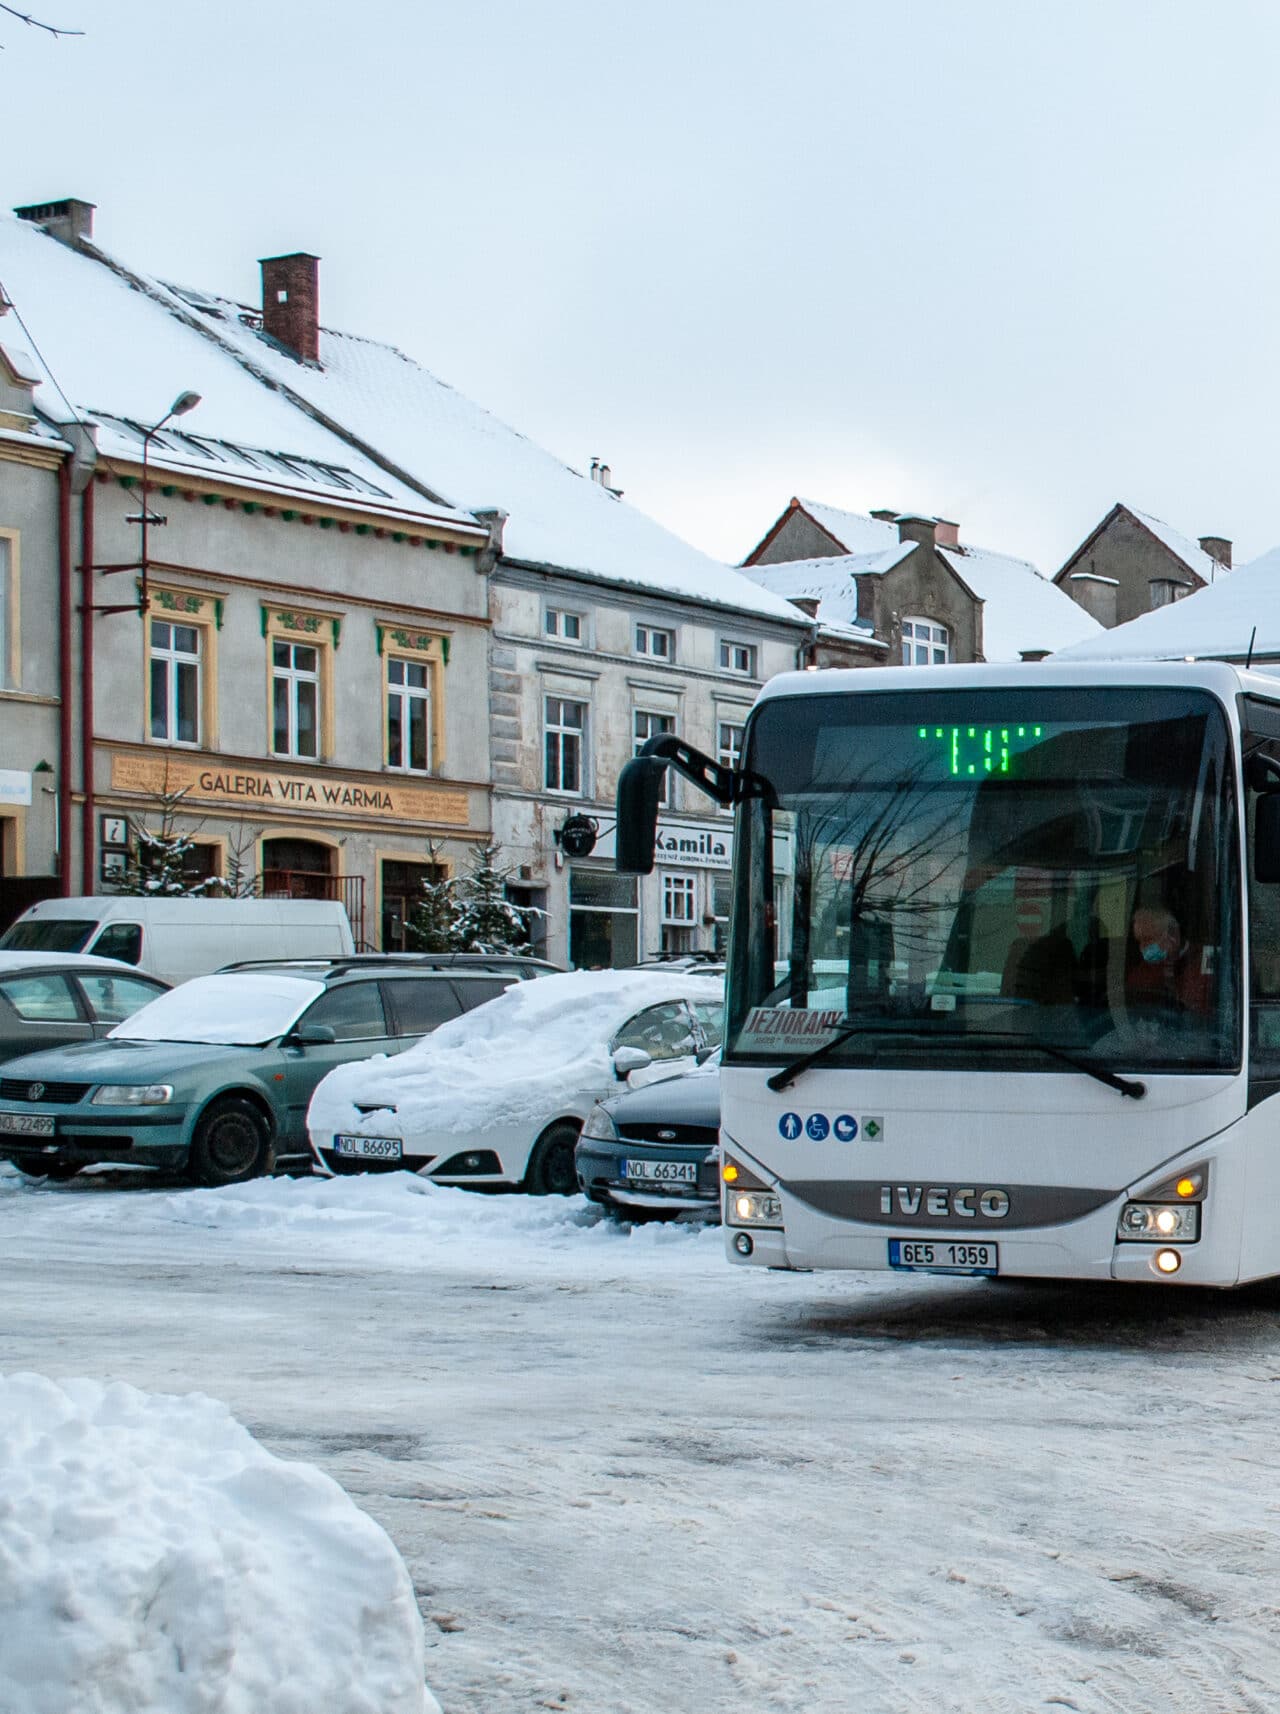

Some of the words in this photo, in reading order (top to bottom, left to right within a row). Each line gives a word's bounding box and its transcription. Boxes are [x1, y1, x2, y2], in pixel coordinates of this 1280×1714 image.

[200, 772, 273, 798] GALERIA
[279, 780, 317, 802] VITA
[322, 785, 393, 810] WARMIA
[655, 830, 726, 856] Kamila
[745, 1009, 844, 1035] JEZIORANY
[363, 1140, 399, 1156] 86695
[627, 1161, 650, 1178] NOL
[654, 1163, 695, 1180] 66341
[880, 1186, 1010, 1218] IVECO
[903, 1244, 934, 1263] 6E5
[947, 1245, 988, 1265] 1359
